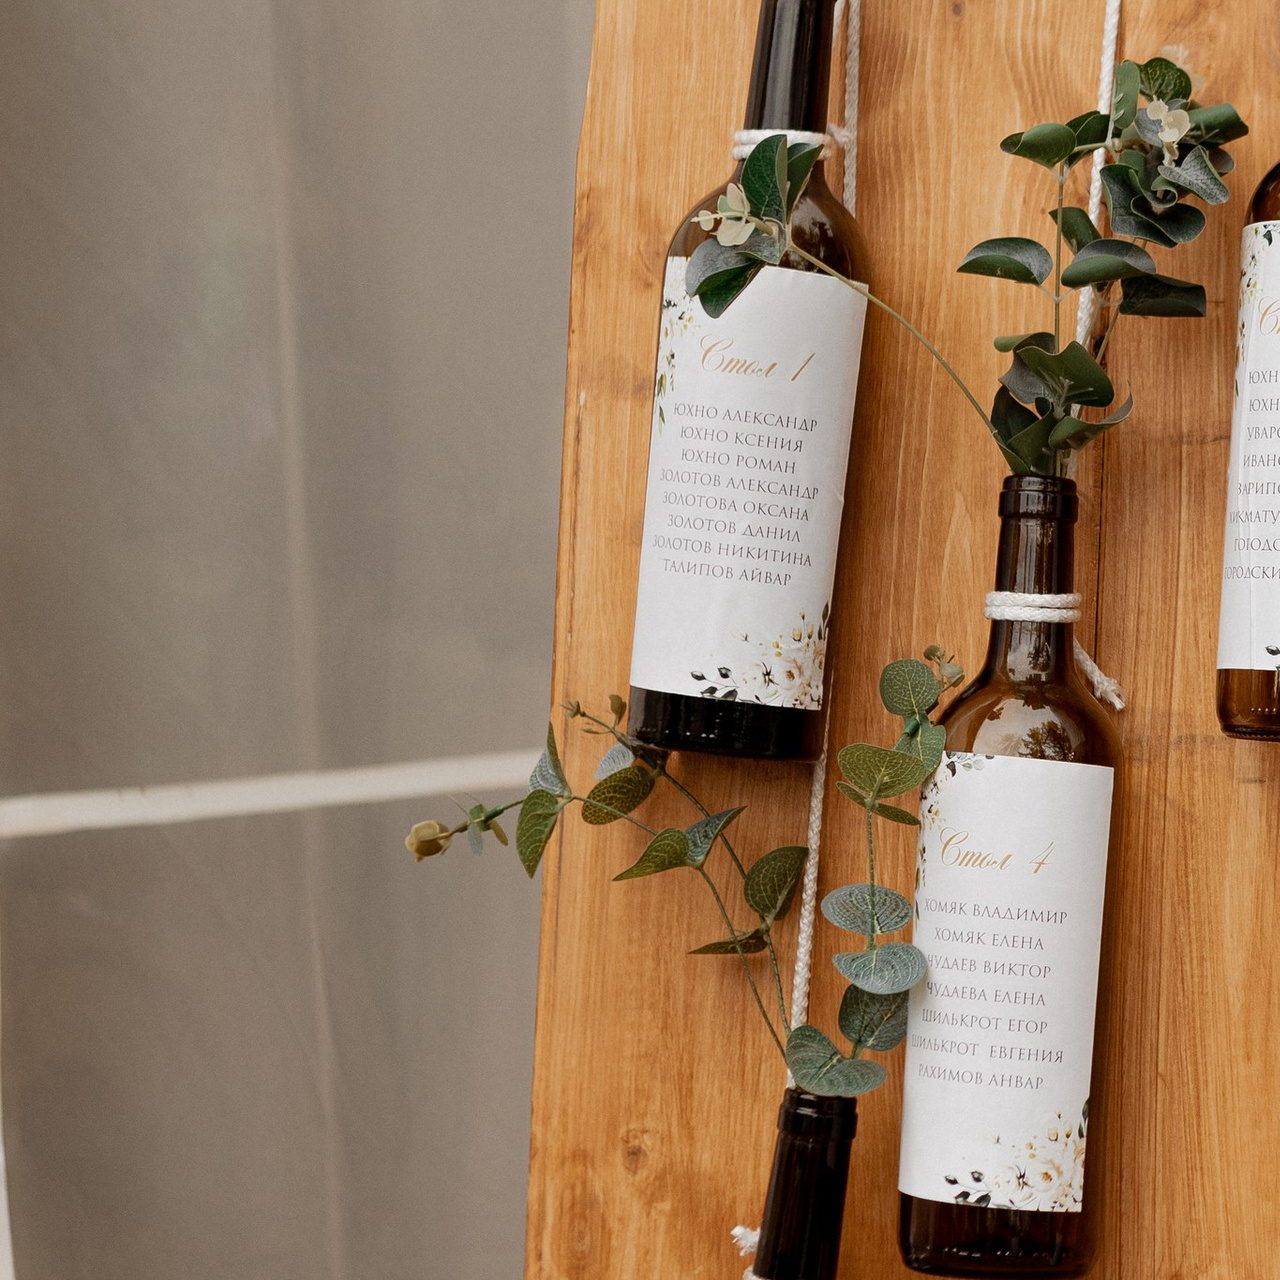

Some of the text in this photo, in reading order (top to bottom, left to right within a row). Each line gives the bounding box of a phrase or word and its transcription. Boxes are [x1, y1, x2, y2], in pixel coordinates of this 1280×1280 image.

[700, 334, 816, 381] Стол 1
[673, 402, 818, 432] ЮХНО АЛЕКСАНДР
[680, 426, 803, 453] ЮХНО КСЕНИЯ
[681, 448, 796, 474] ЮХНО РОМАН
[660, 468, 819, 500] ЗОЛОТОВ АЛЕКСАНДР
[662, 491, 809, 522] ЗОЛОТОВА ОКСАНА
[667, 514, 801, 543] ЗОЛОТОВ ДАНИЛ
[652, 534, 813, 567] ЗОЛОТОВ НИКИТИНА
[663, 558, 792, 586] ТАЛИПОВ АЙВАР
[939, 826, 1056, 874] Стол 4
[924, 898, 1068, 924] ХОМЯК ВЛАДИМИР
[933, 927, 1044, 950] ХОМЯК ЕЛЕНА
[927, 953, 1051, 979] ЧУДАЕВ ВИКТОР
[927, 981, 1046, 1007] ЧУДАЕВА ЕЛЕНА
[922, 1008, 1048, 1035] ШИЛЬКРОТ ЕГОР
[911, 1033, 1064, 1064] ШИЛЬКРОТ ЕВГЕНИЯ
[918, 1063, 1044, 1090] РАХИМОВ АНВАР
